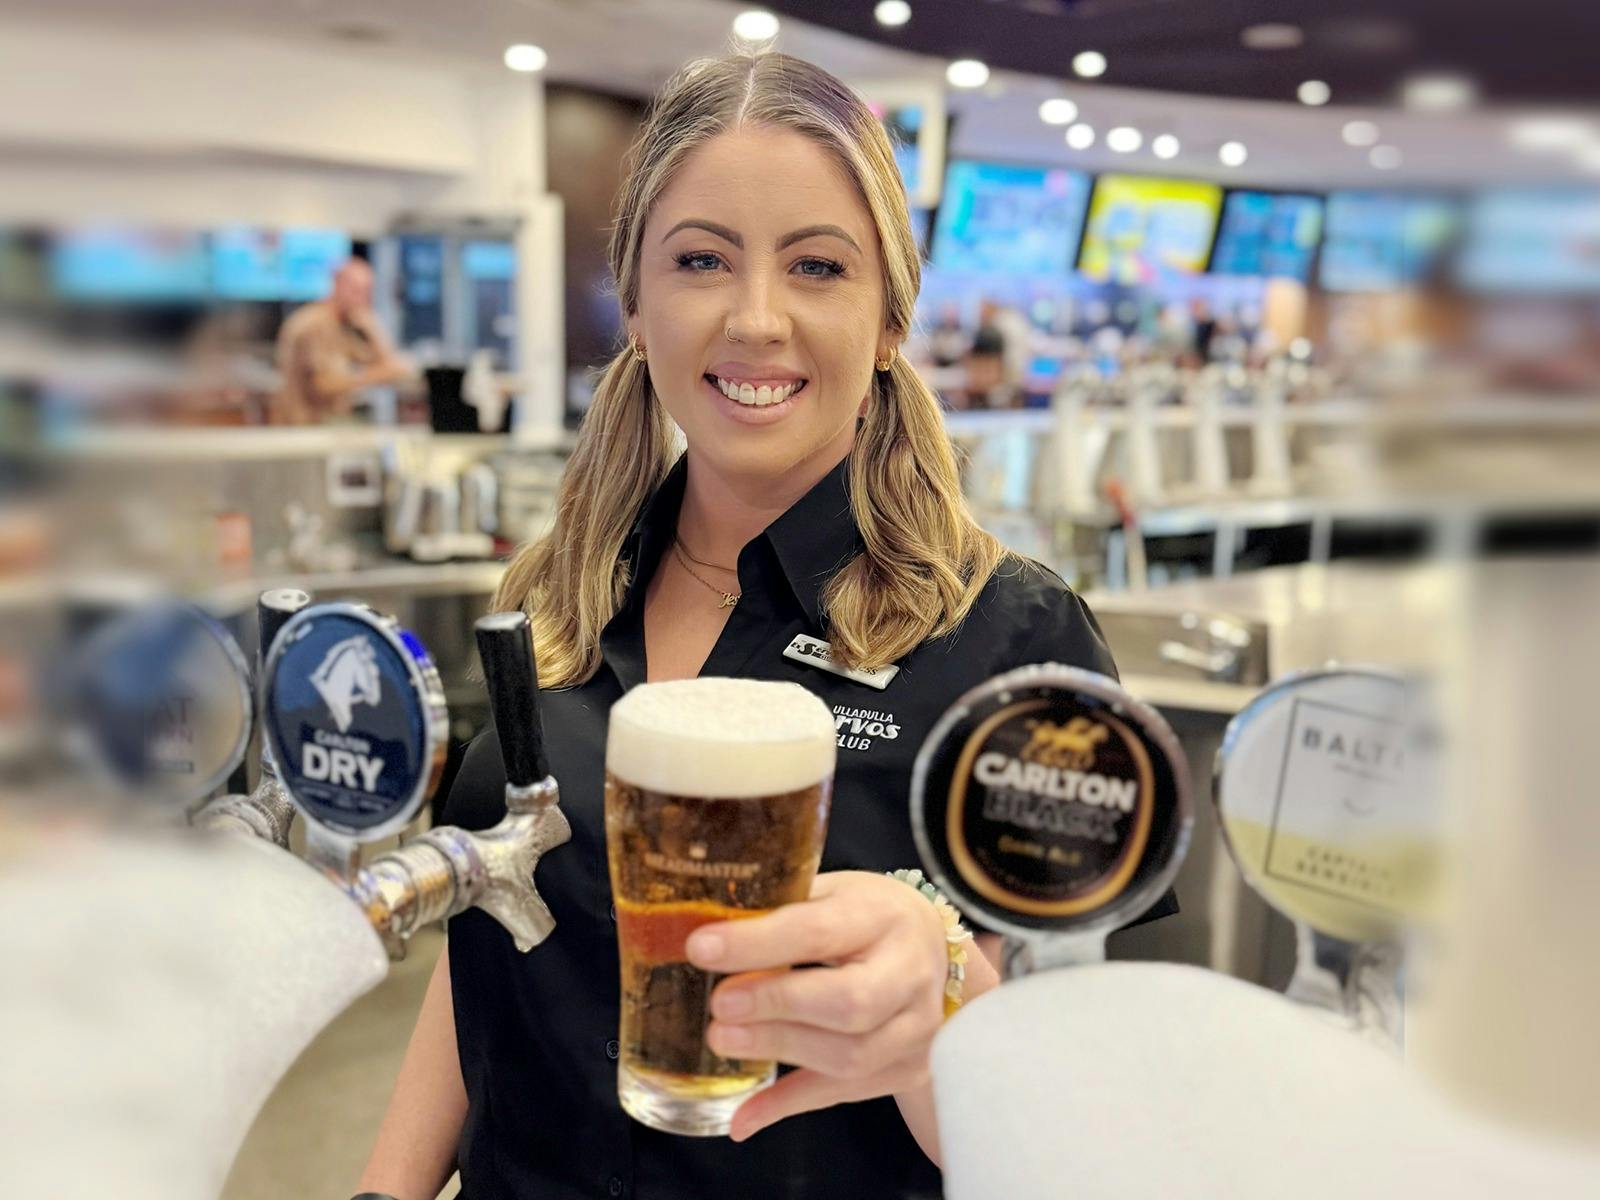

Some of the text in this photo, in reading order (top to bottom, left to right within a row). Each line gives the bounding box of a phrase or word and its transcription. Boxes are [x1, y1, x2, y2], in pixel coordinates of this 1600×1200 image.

[833, 705, 893, 723] ULLADULLA
[835, 715, 901, 739] rvos
[836, 734, 871, 750] LUB
[1303, 727, 1406, 771] BALT
[303, 743, 384, 793] DRY
[973, 752, 1137, 812] CARLTON
